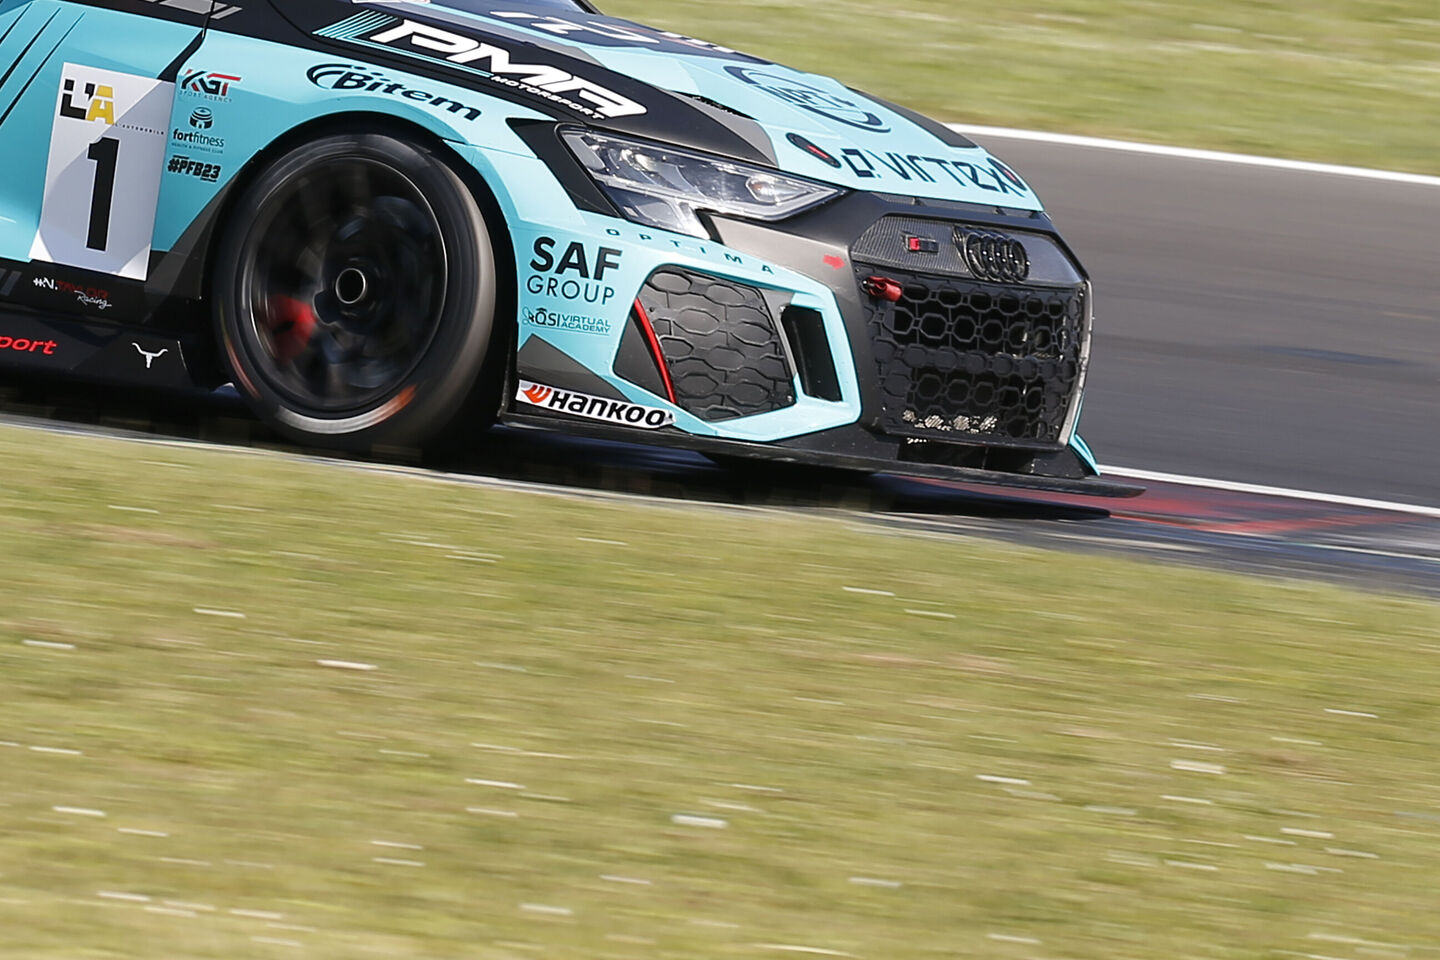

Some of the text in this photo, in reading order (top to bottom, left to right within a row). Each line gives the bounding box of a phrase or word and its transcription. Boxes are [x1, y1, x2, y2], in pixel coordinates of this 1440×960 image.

[330, 66, 483, 122] Bitem
[490, 74, 606, 120] MOTORSPORT
[172, 128, 225, 148] fortfitness
[167, 156, 222, 180] #PFB23
[86, 136, 120, 252] 1
[529, 236, 623, 282] SAF
[605, 228, 775, 275] OPTIMA
[74, 289, 113, 310] Racing
[526, 274, 615, 306] GROUP
[560, 321, 610, 334] ACADEMY
[561, 313, 611, 327] VIRTUAL
